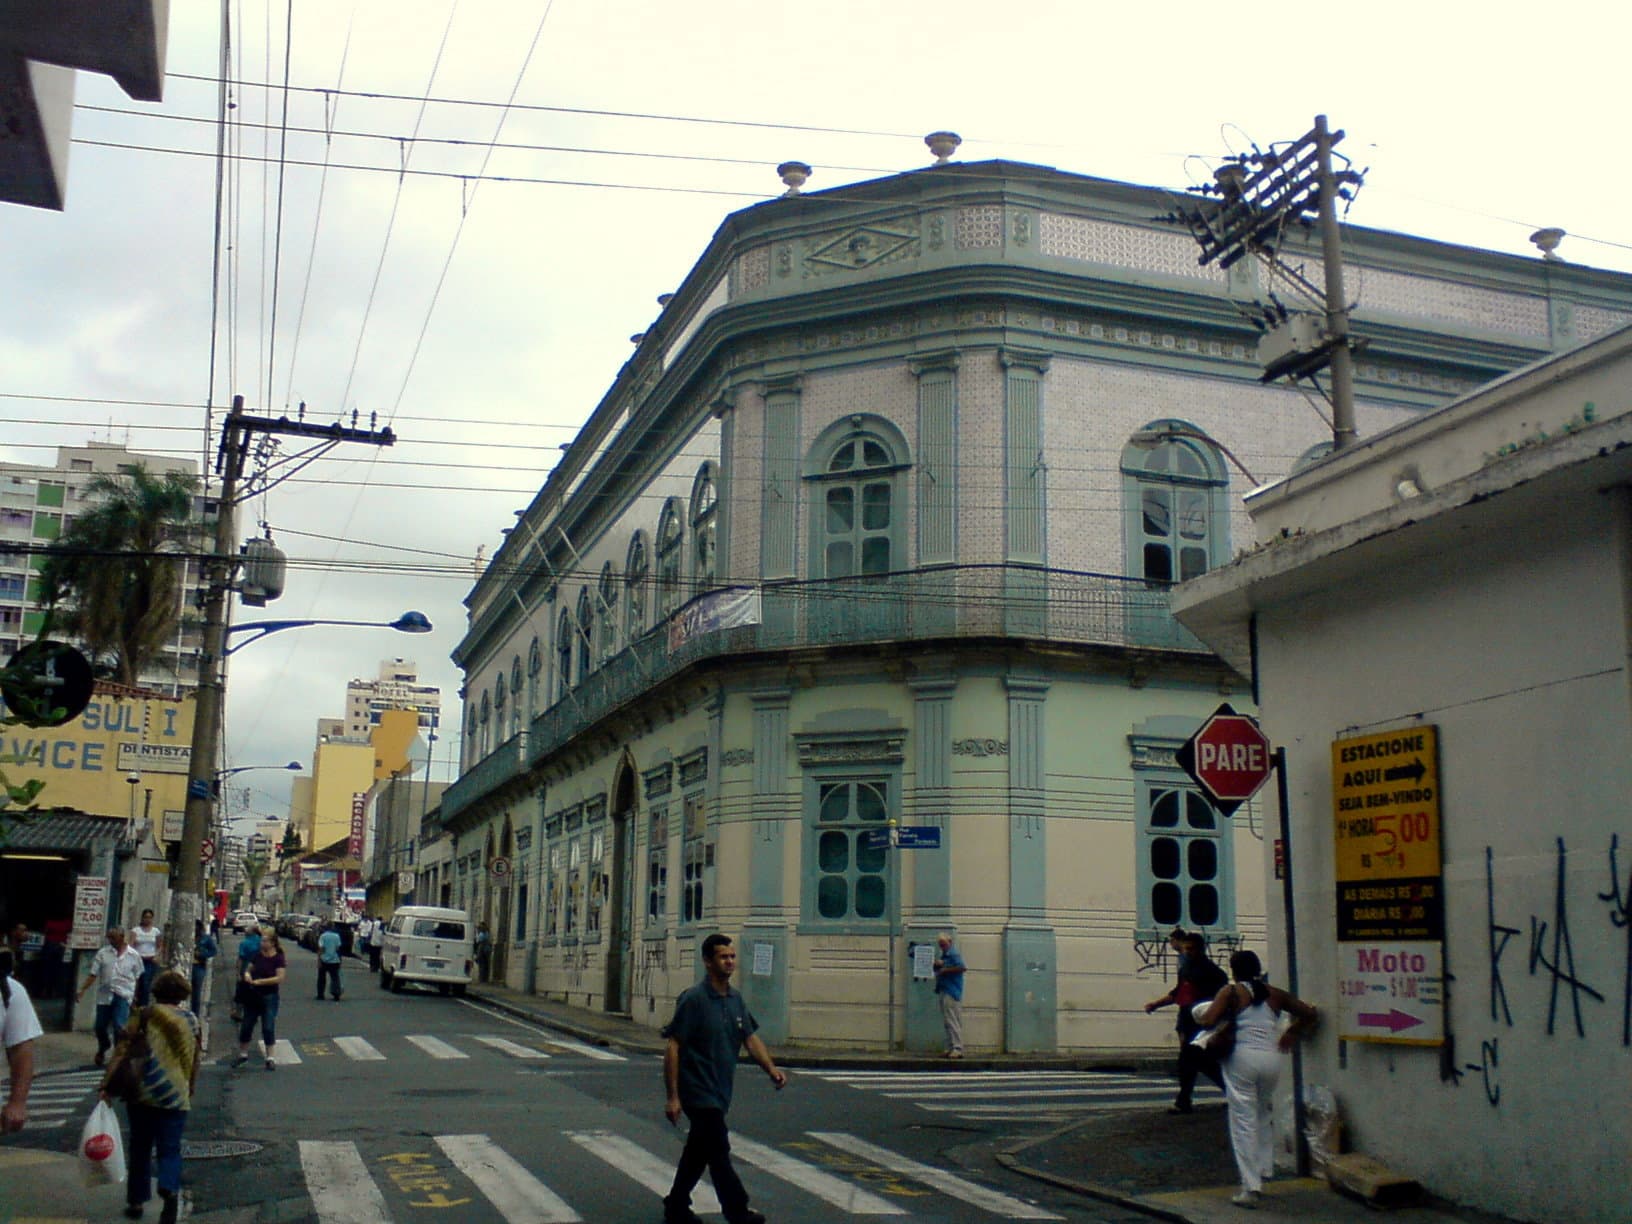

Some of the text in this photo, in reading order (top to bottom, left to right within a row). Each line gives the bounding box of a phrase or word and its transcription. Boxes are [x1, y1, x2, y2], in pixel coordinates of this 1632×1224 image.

[1201, 744, 1263, 771] PARE
[1341, 735, 1424, 763] ESTACIONE
[1343, 768, 1382, 787] AQUI
[1339, 788, 1432, 811] SEJA BEM-VINDO
[1357, 949, 1425, 973] Moto
